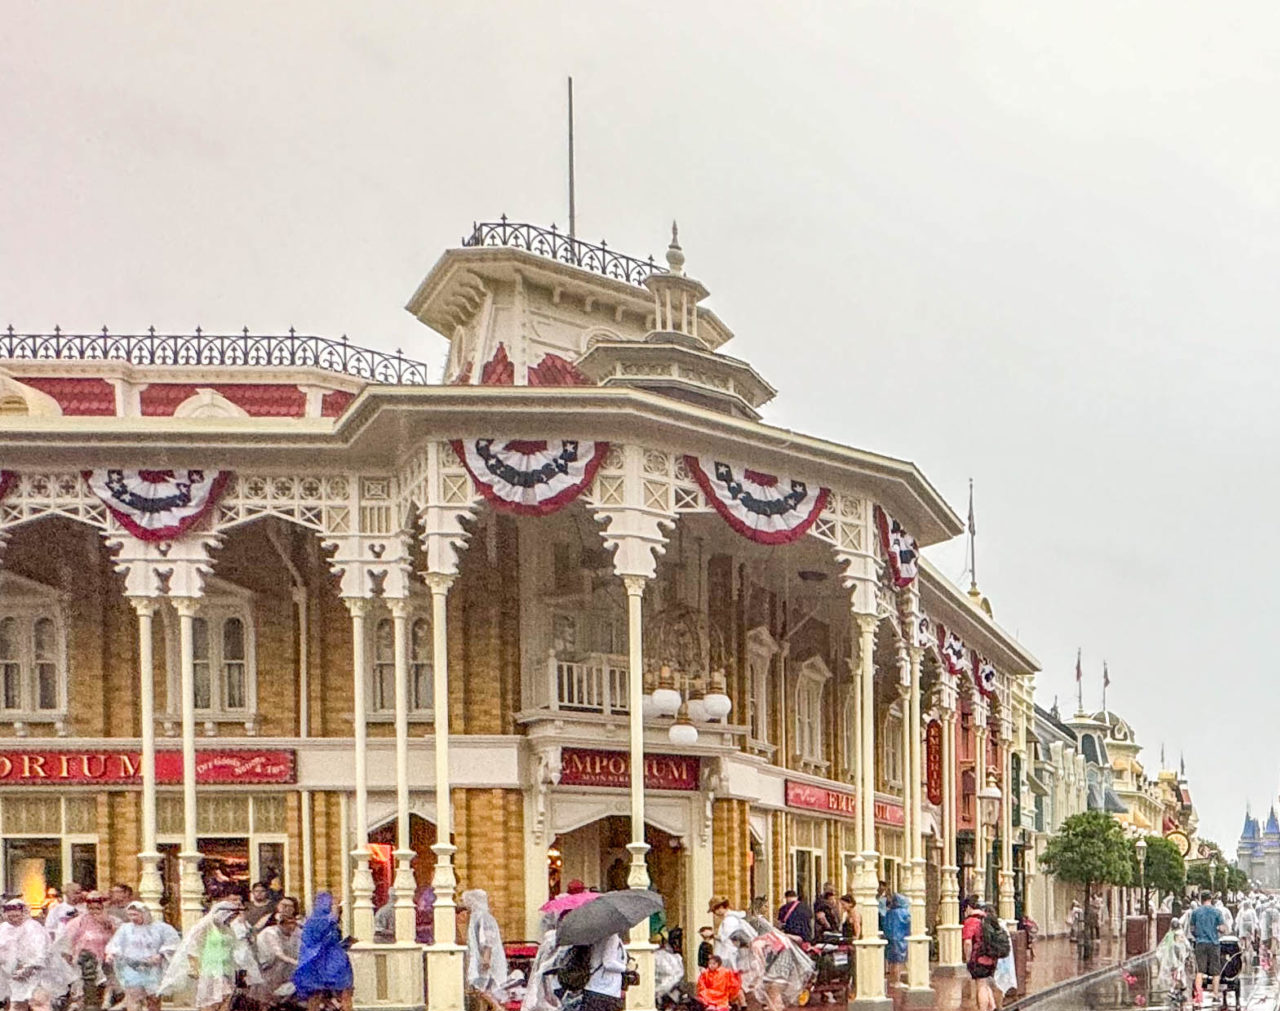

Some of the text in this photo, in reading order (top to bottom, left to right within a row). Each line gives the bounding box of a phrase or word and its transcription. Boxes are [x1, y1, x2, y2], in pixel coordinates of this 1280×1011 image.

[562, 754, 687, 780] EMPOIUM
[929, 726, 940, 797] EMPORIUM
[827, 791, 891, 821] EMPUM
